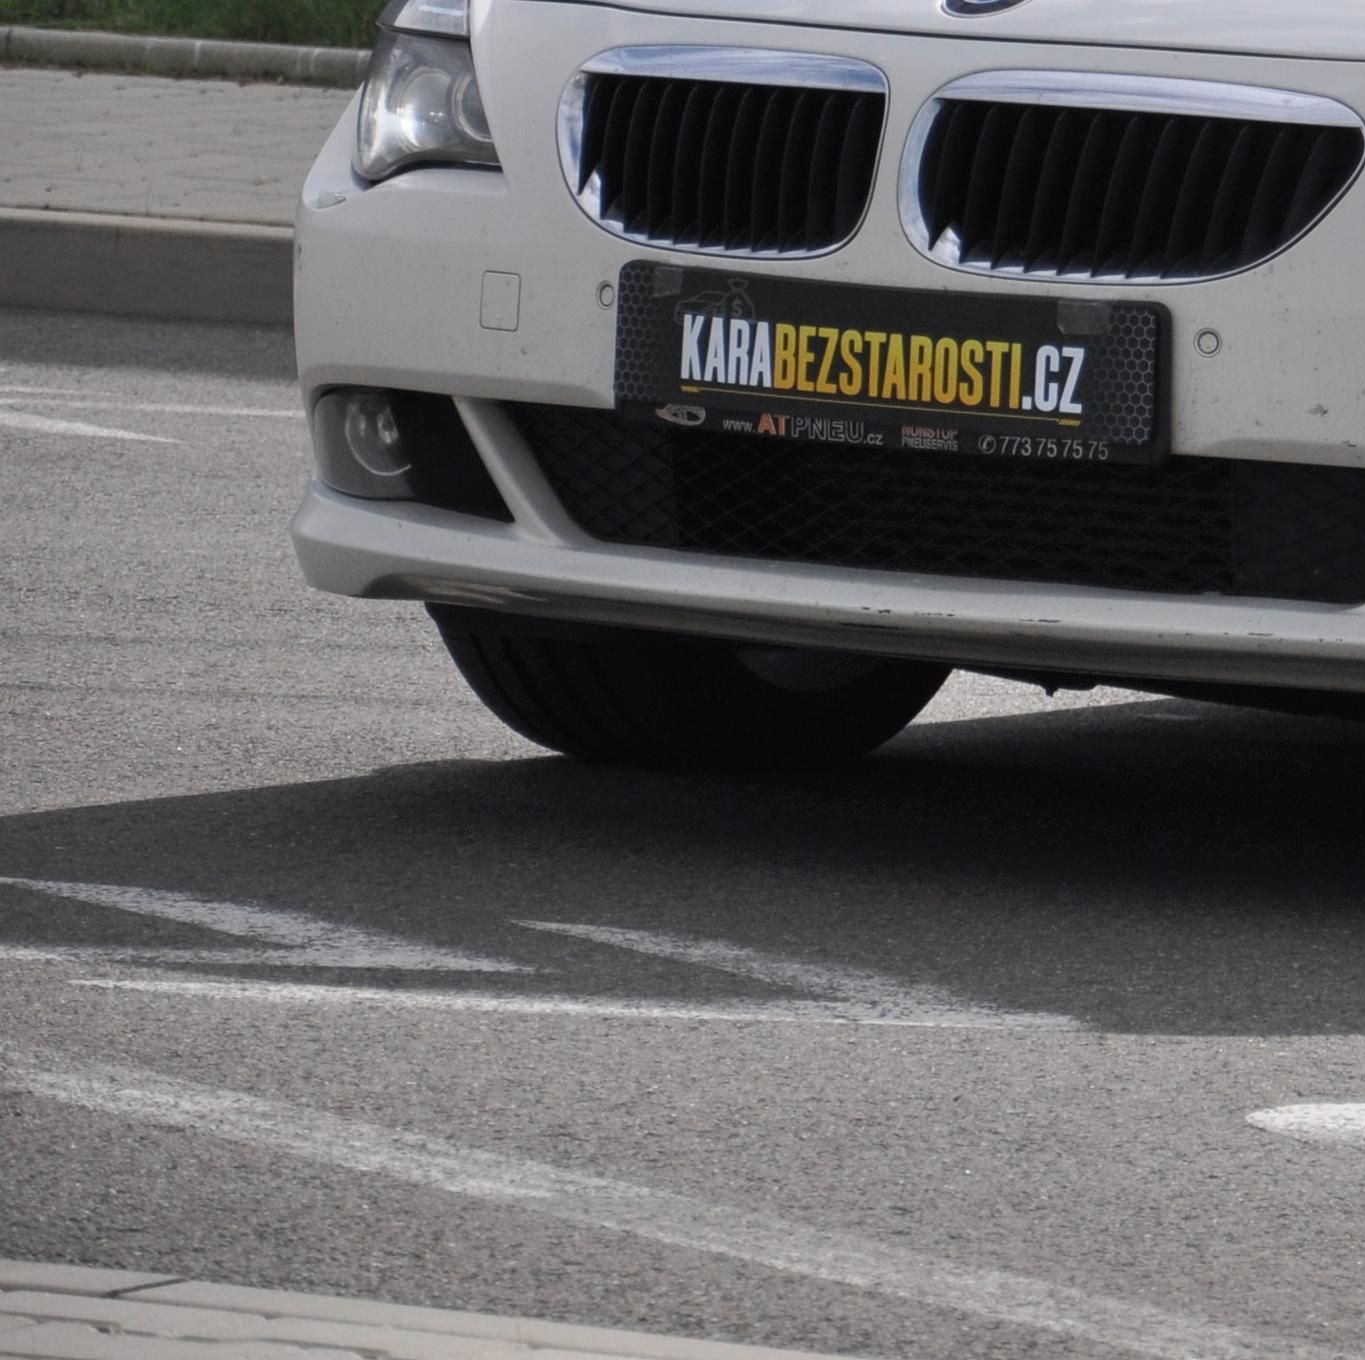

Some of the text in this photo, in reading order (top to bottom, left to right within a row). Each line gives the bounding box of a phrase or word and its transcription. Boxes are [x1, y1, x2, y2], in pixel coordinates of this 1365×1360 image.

[680, 313, 1085, 415] KARABEZSTAROSTI.CZ
[901, 437, 959, 452] PNEUSERVIS
[999, 435, 1032, 457] 773
